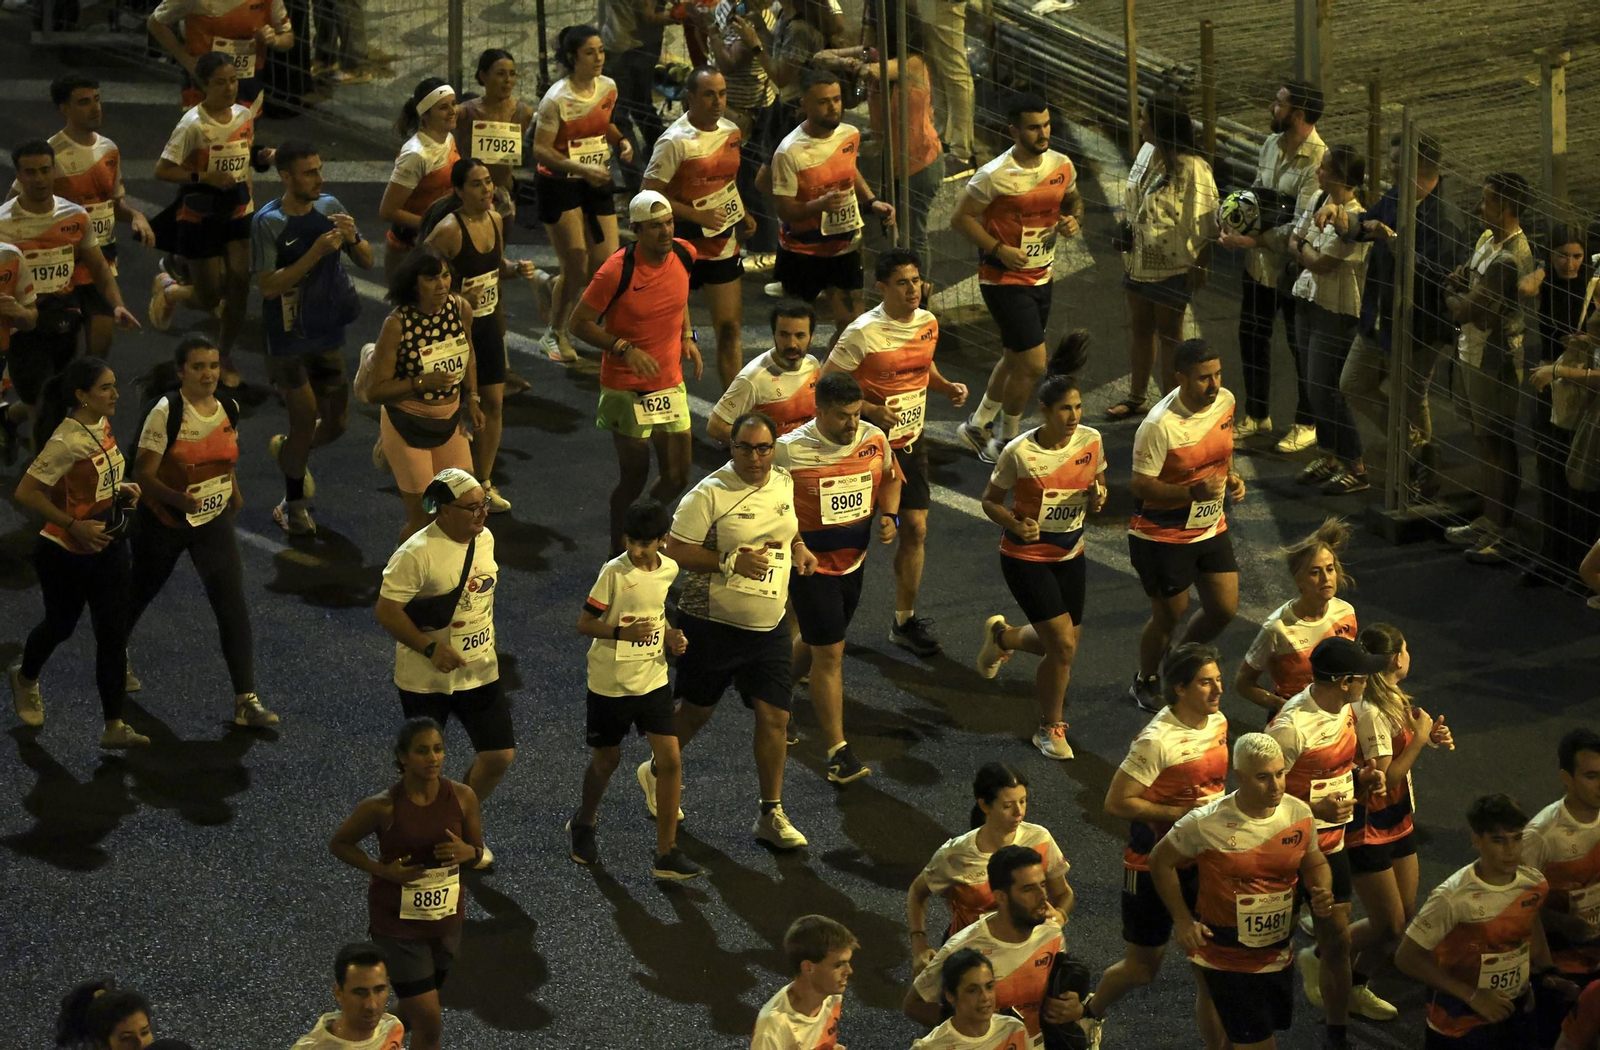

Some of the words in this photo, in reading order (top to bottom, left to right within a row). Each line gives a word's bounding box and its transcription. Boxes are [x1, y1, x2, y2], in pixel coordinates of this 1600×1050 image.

[233, 56, 248, 68] 65
[478, 137, 515, 153] 17982
[215, 157, 246, 171] 18627
[61, 221, 80, 234] KH7
[31, 263, 69, 281] 19748
[433, 356, 463, 374] 6304
[640, 396, 671, 413] 1628
[858, 444, 878, 458] KH7
[1075, 452, 1092, 467] KH7
[831, 492, 863, 511] 8908
[1044, 505, 1083, 521] 20041
[462, 628, 490, 651] 2602
[1281, 830, 1303, 849] KH7
[413, 888, 450, 908] 8887
[1244, 911, 1287, 933] 15481
[1034, 951, 1054, 970] KH7
[1490, 966, 1521, 990] 9575
